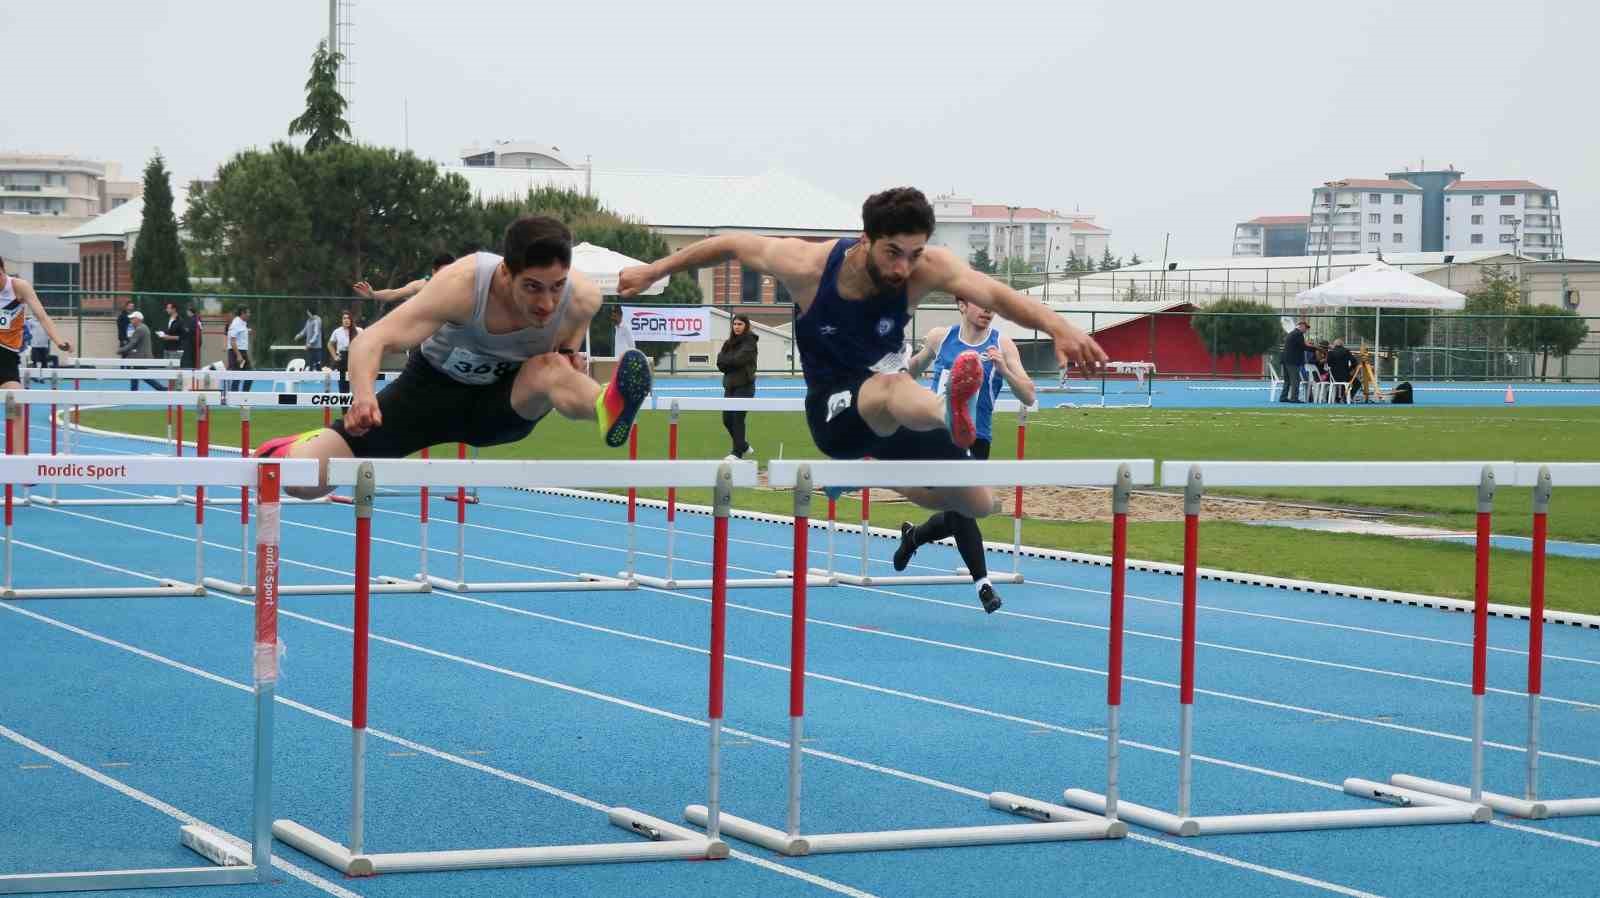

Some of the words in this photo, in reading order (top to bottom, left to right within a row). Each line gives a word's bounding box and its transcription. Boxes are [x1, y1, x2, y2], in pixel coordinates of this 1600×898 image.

[631, 317, 703, 331] SPORTOTO
[454, 361, 511, 377] 368
[87, 465, 127, 480] Sport
[263, 575, 275, 607] Sport
